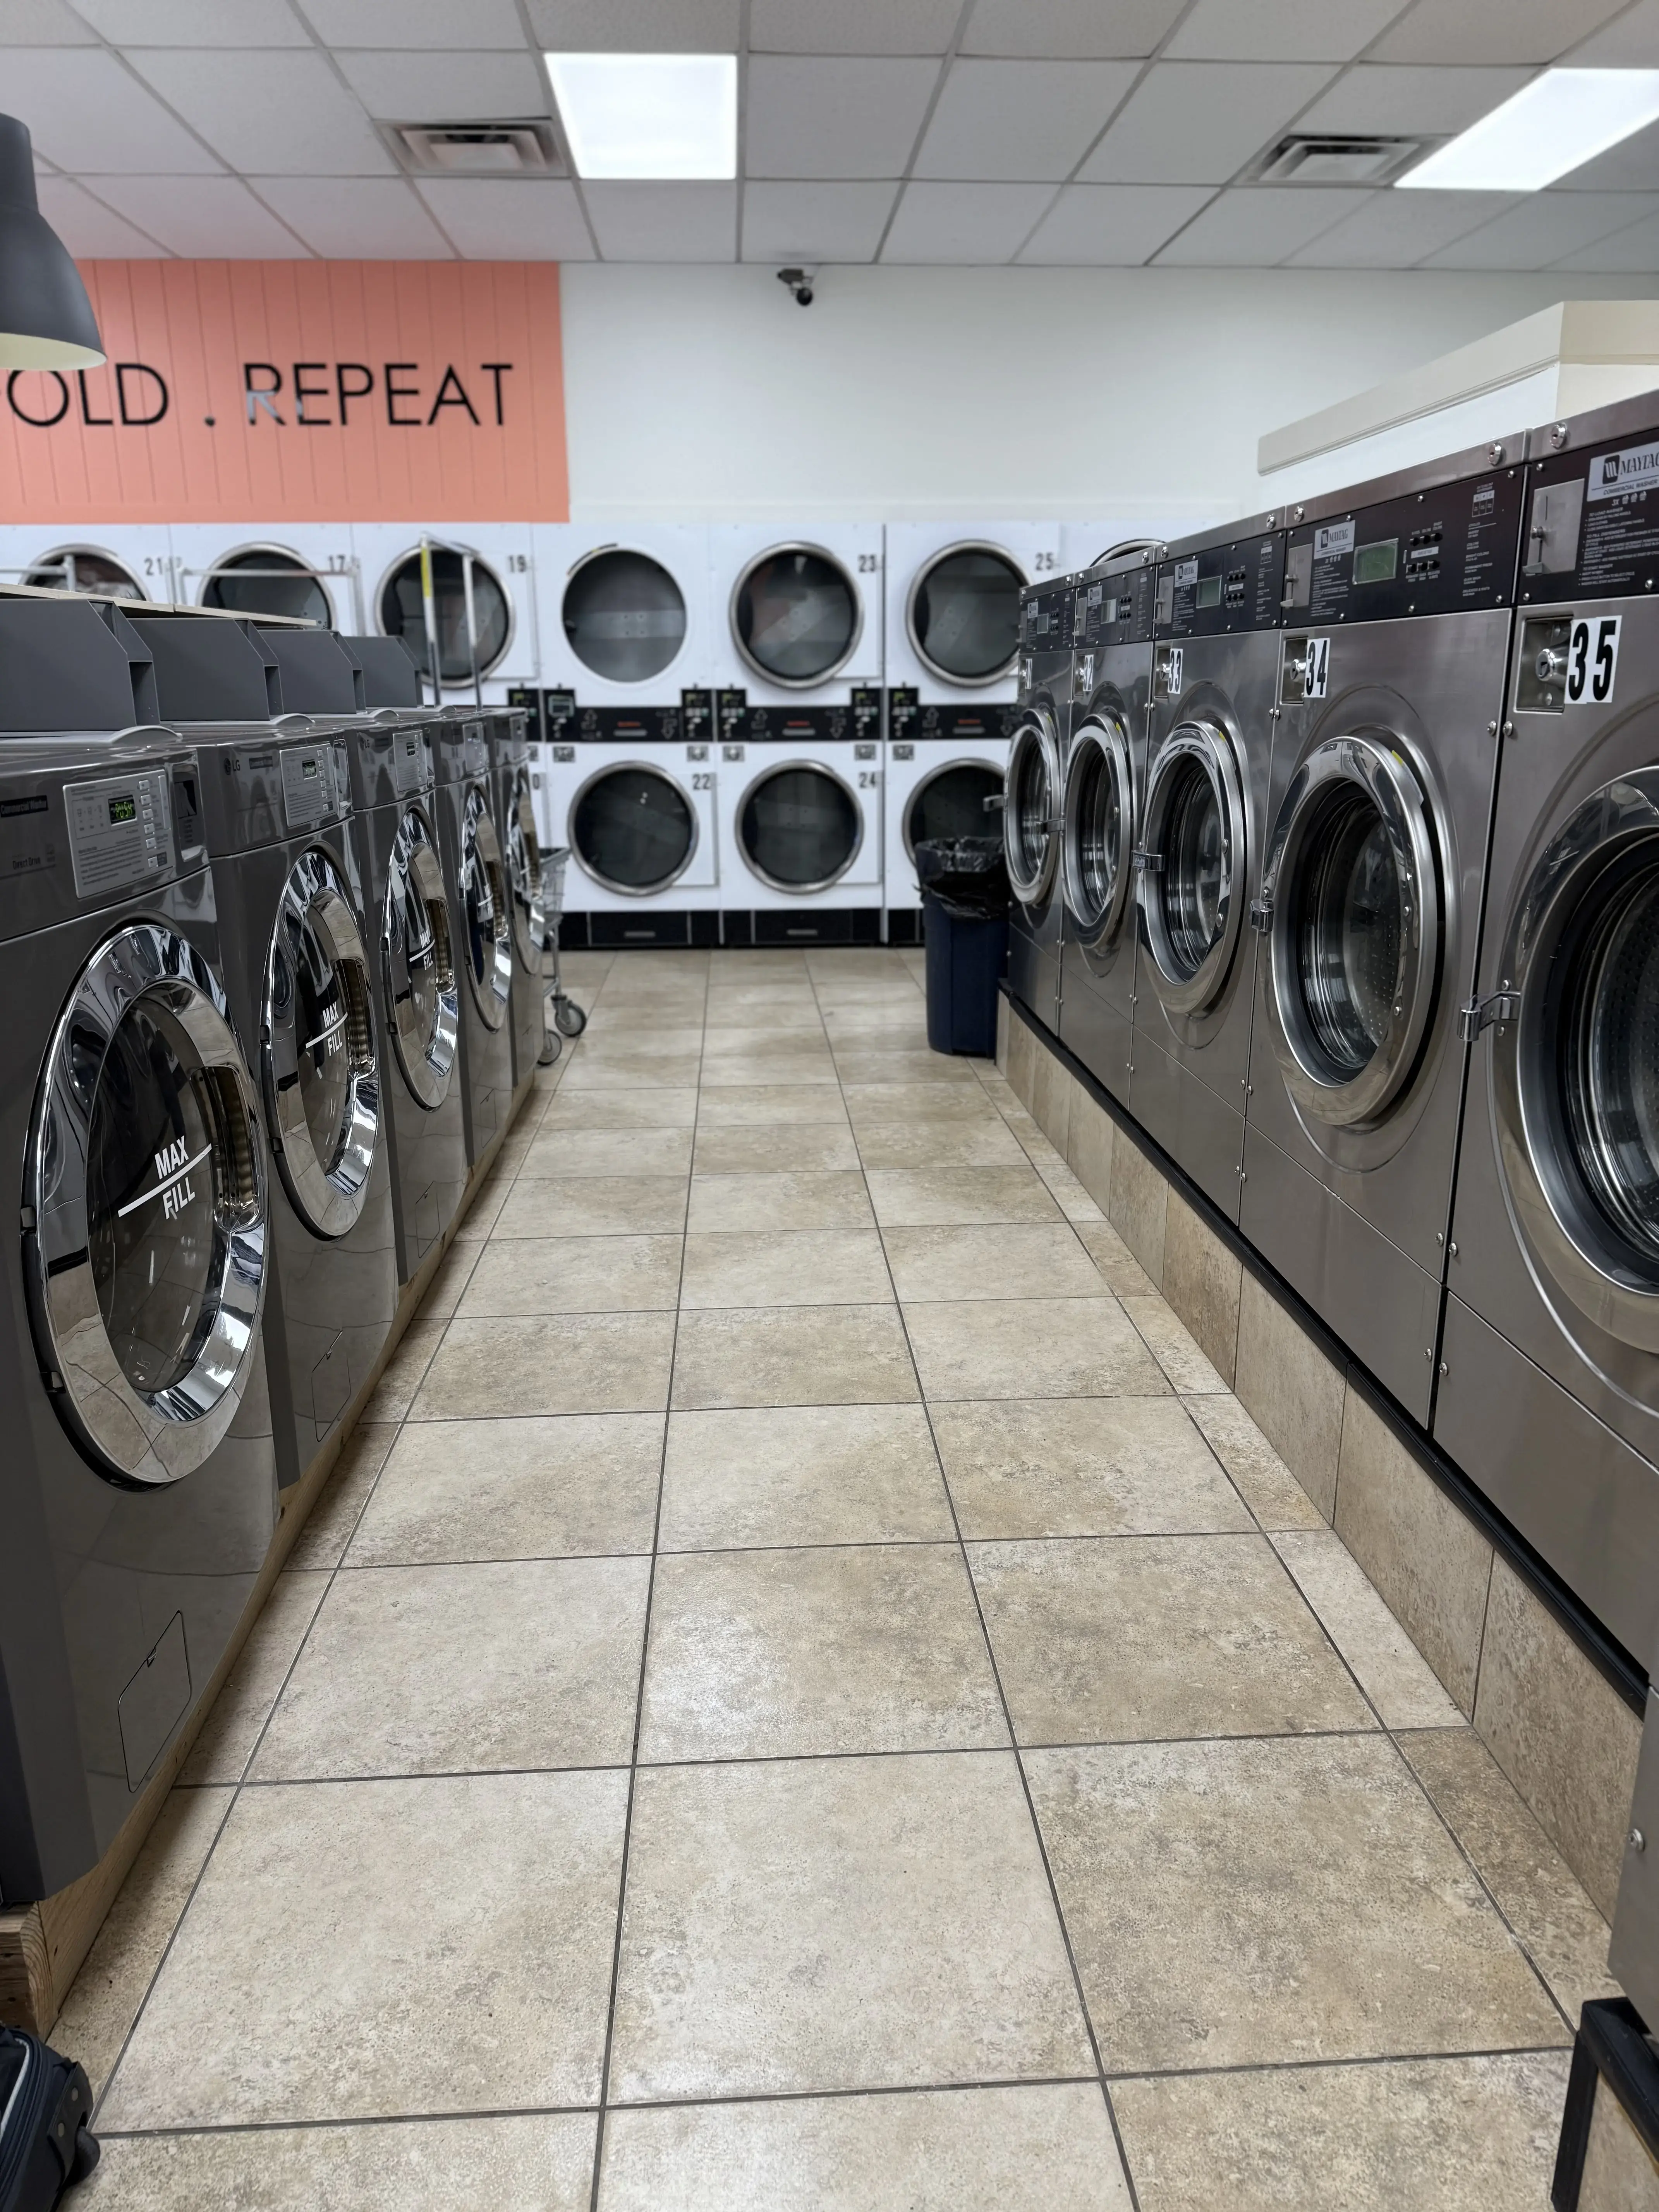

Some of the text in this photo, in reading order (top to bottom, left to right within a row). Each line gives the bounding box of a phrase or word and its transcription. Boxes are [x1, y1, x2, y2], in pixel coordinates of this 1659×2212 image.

[244, 363, 513, 426] REPEAT
[1329, 529, 1348, 542] MAYTAG
[328, 555, 345, 574] 17
[858, 554, 876, 573] 23
[1035, 552, 1053, 571] 25
[1306, 640, 1327, 696] 34
[1569, 620, 1616, 701] 35
[1084, 656, 1093, 690] 32
[1169, 651, 1181, 692] 33
[232, 760, 240, 772] LG
[693, 774, 710, 790] 22
[858, 771, 876, 789] 24
[420, 929, 431, 949] MAX
[423, 951, 433, 970] FILL
[323, 1001, 339, 1029] MAX
[327, 1036, 343, 1056] FILL
[155, 1135, 189, 1180] MAX
[162, 1177, 196, 1219] FILL
